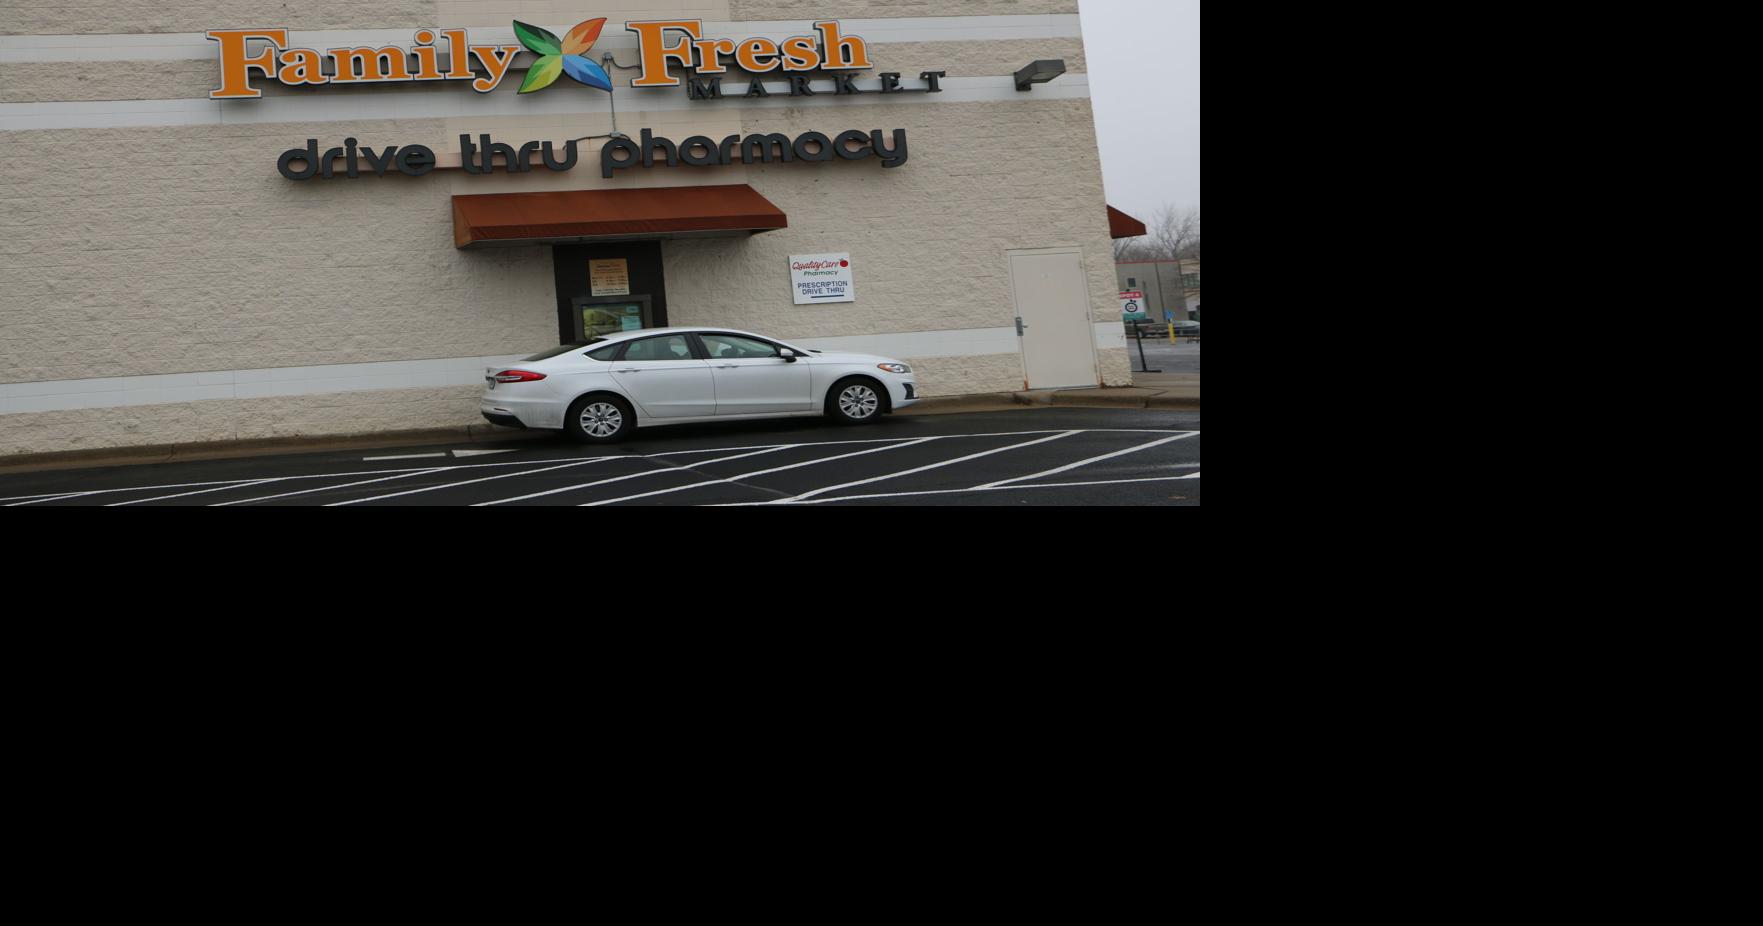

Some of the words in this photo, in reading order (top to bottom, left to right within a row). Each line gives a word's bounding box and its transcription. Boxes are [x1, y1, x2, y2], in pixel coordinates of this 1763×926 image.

[206, 28, 520, 99] Family
[625, 19, 873, 88] Fresh
[688, 71, 945, 99] MARKET
[277, 137, 436, 180] drive
[460, 134, 576, 175] thru
[600, 127, 908, 178] pharmacy
